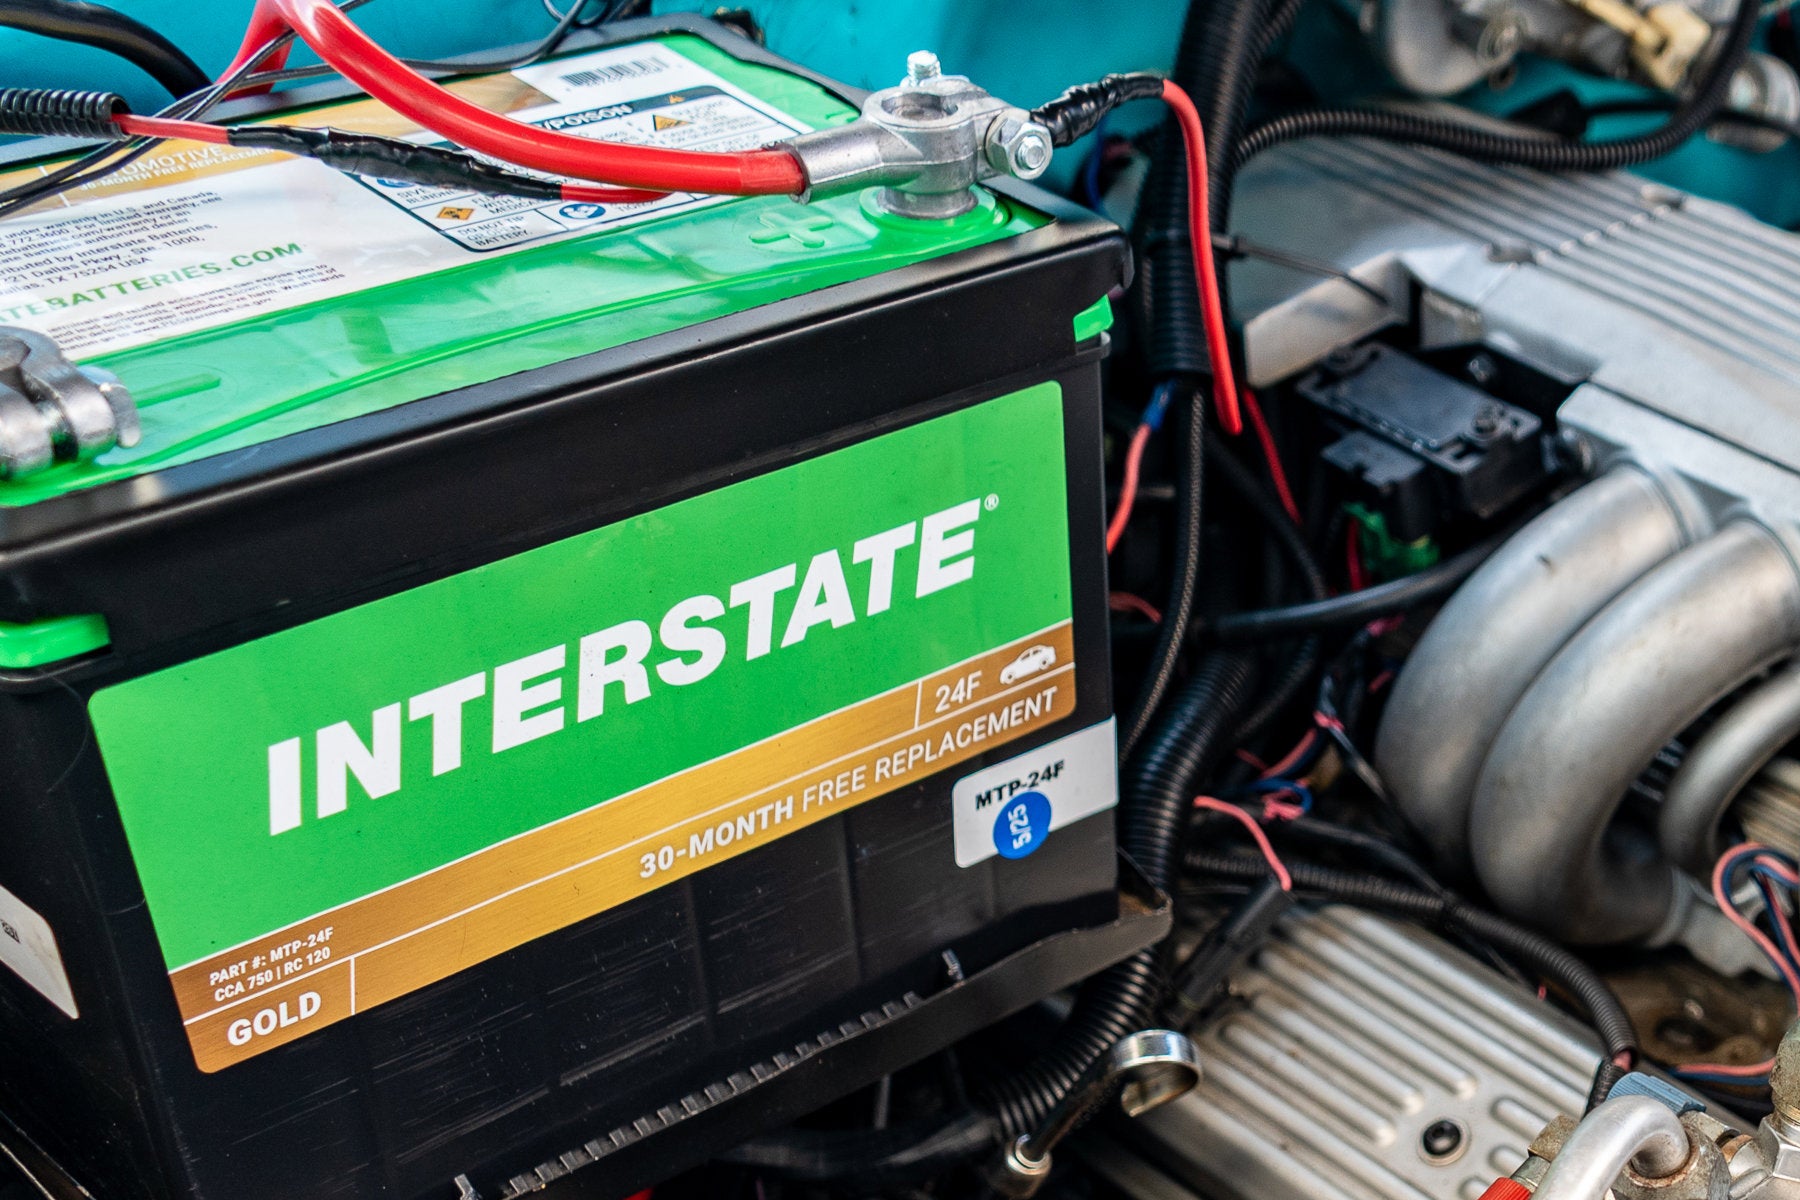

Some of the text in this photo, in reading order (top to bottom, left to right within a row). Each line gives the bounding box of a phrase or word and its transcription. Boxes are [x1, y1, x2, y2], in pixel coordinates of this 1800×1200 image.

[154, 165, 187, 177] FREE
[5, 225, 41, 240] under
[46, 211, 98, 230] warranty
[143, 200, 166, 212] and
[167, 191, 219, 205] Canada,
[76, 220, 96, 232] For
[100, 211, 142, 228] limited
[144, 203, 200, 220] warranty,
[86, 227, 150, 246] authorized
[55, 252, 75, 267] by
[76, 236, 146, 260] Interstate
[149, 222, 219, 243] Batteries,
[31, 260, 80, 278] Dallas
[46, 273, 69, 285] TX
[71, 263, 118, 280] 75254
[118, 256, 152, 271] USA
[933, 669, 984, 714] 24F
[639, 684, 1059, 879] 30-MONTH FREE REPLACEMENT
[975, 758, 1066, 812] MTP-24F
[1006, 803, 1033, 850] 5/25
[209, 960, 249, 987] PART
[270, 926, 334, 963] MTP-24F
[214, 946, 332, 1002] CCA 750 RC 120
[227, 991, 322, 1047] GOLD
